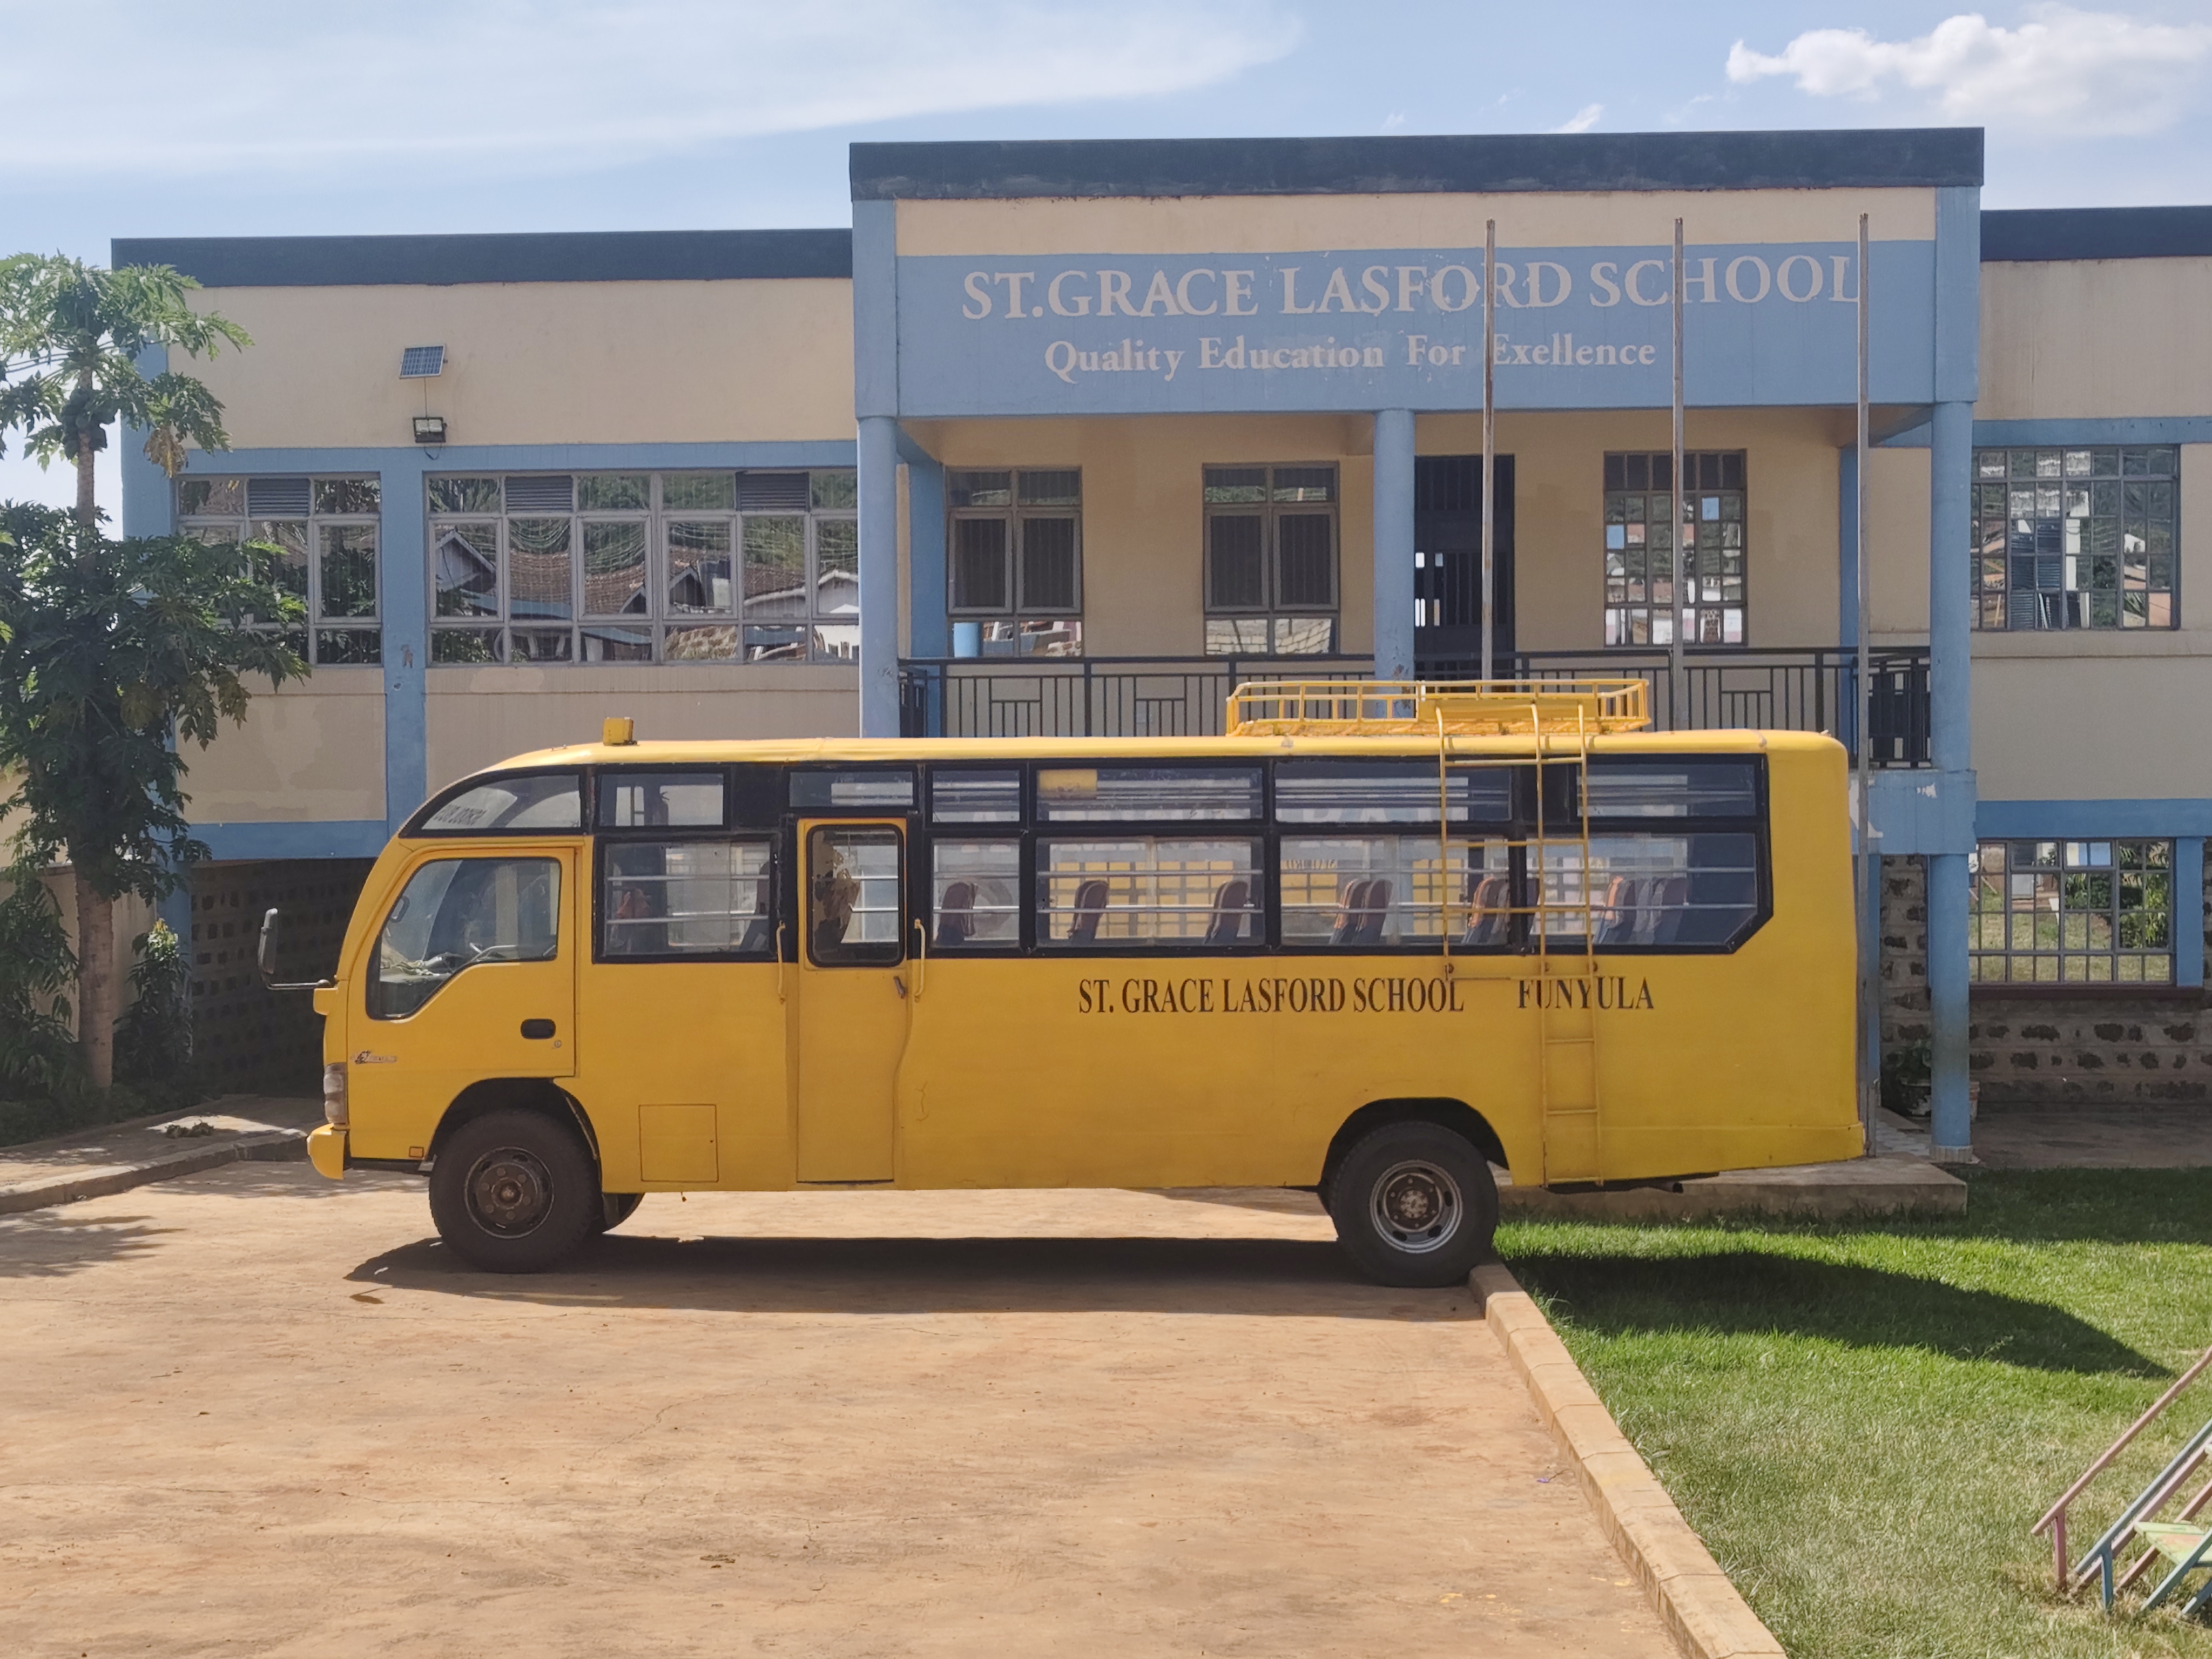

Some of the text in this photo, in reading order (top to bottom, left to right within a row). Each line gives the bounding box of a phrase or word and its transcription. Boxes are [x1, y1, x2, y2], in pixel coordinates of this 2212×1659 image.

[962, 255, 1859, 320] ST.GRACE LASFORD SCHOOL
[1044, 332, 1656, 384] Quality Education For Exellence
[1080, 977, 1464, 1014] ST. GRACE LASFORD SCHOOL
[1518, 977, 1654, 1009] FUNYULA
